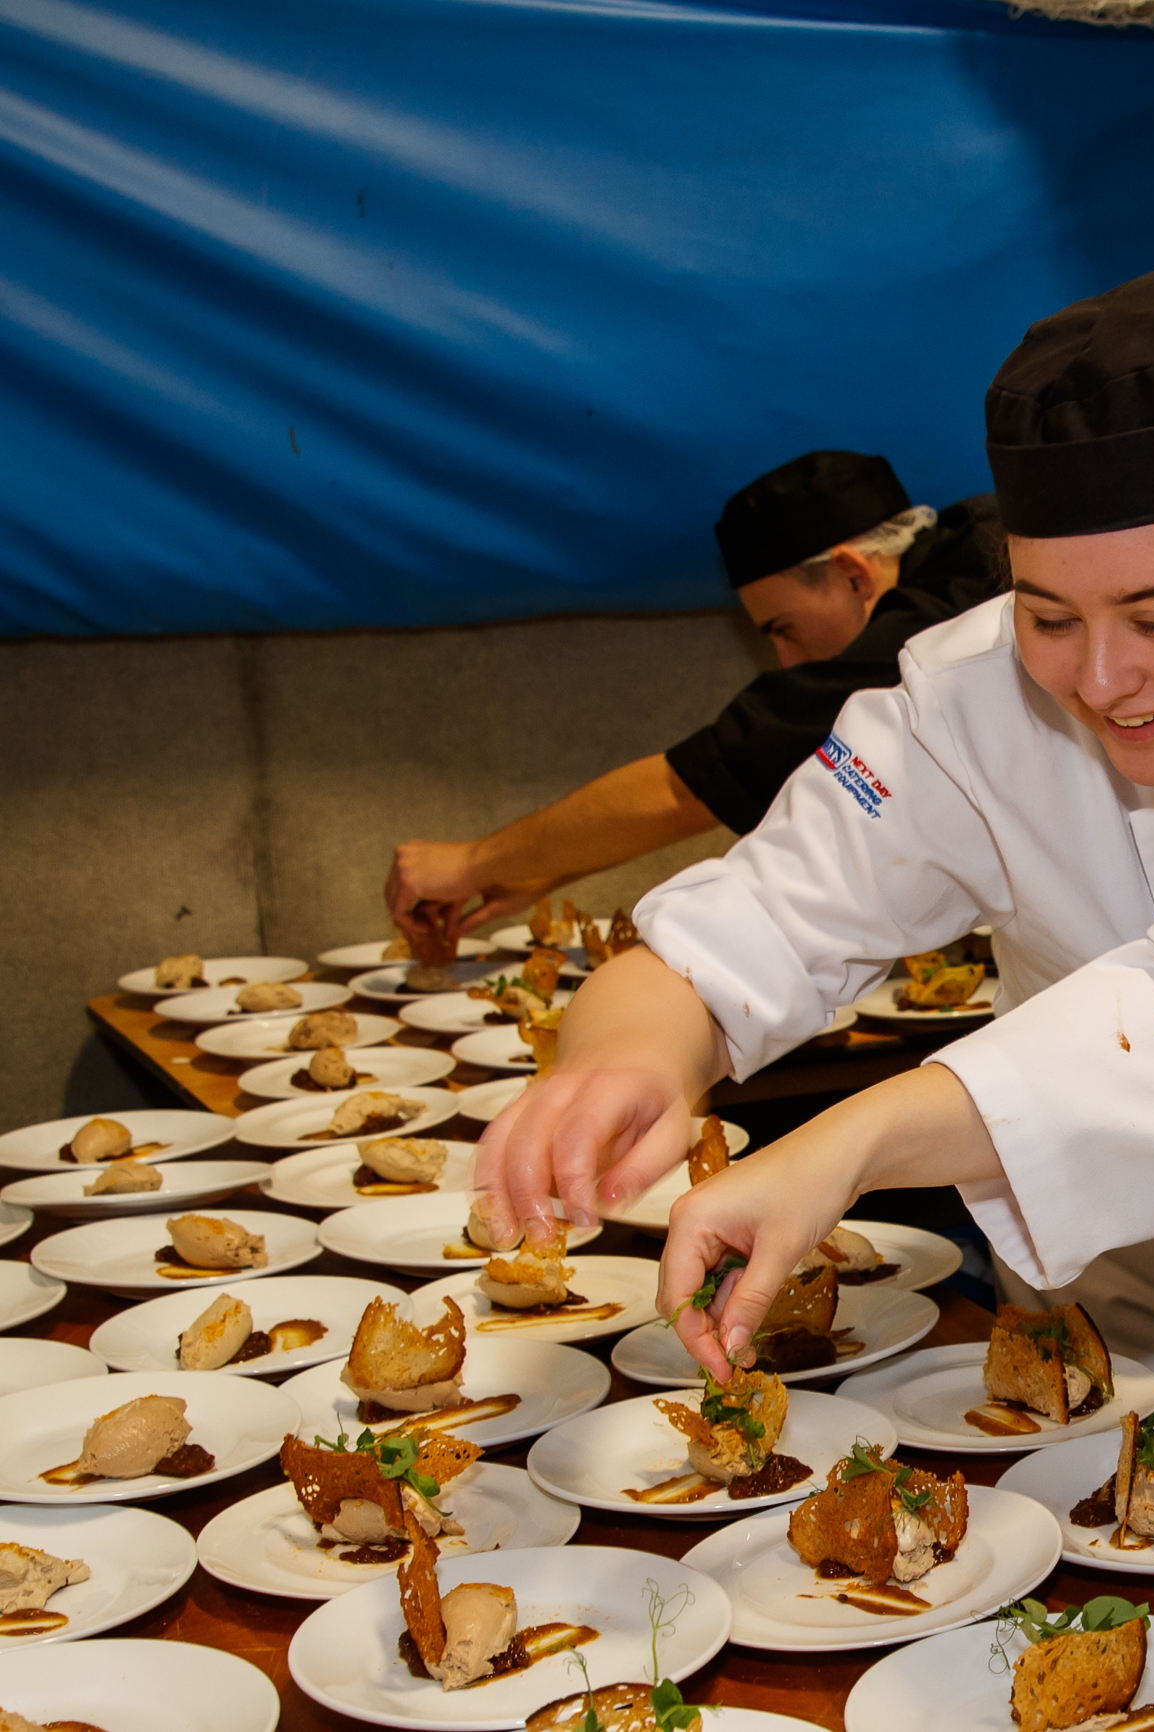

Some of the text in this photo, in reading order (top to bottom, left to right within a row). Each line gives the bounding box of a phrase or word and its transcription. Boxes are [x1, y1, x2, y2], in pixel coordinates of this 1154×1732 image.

[833, 771, 881, 819] EQUIPMENT
[841, 764, 883, 806] CATERING
[850, 756, 892, 799] NEXT DAY
